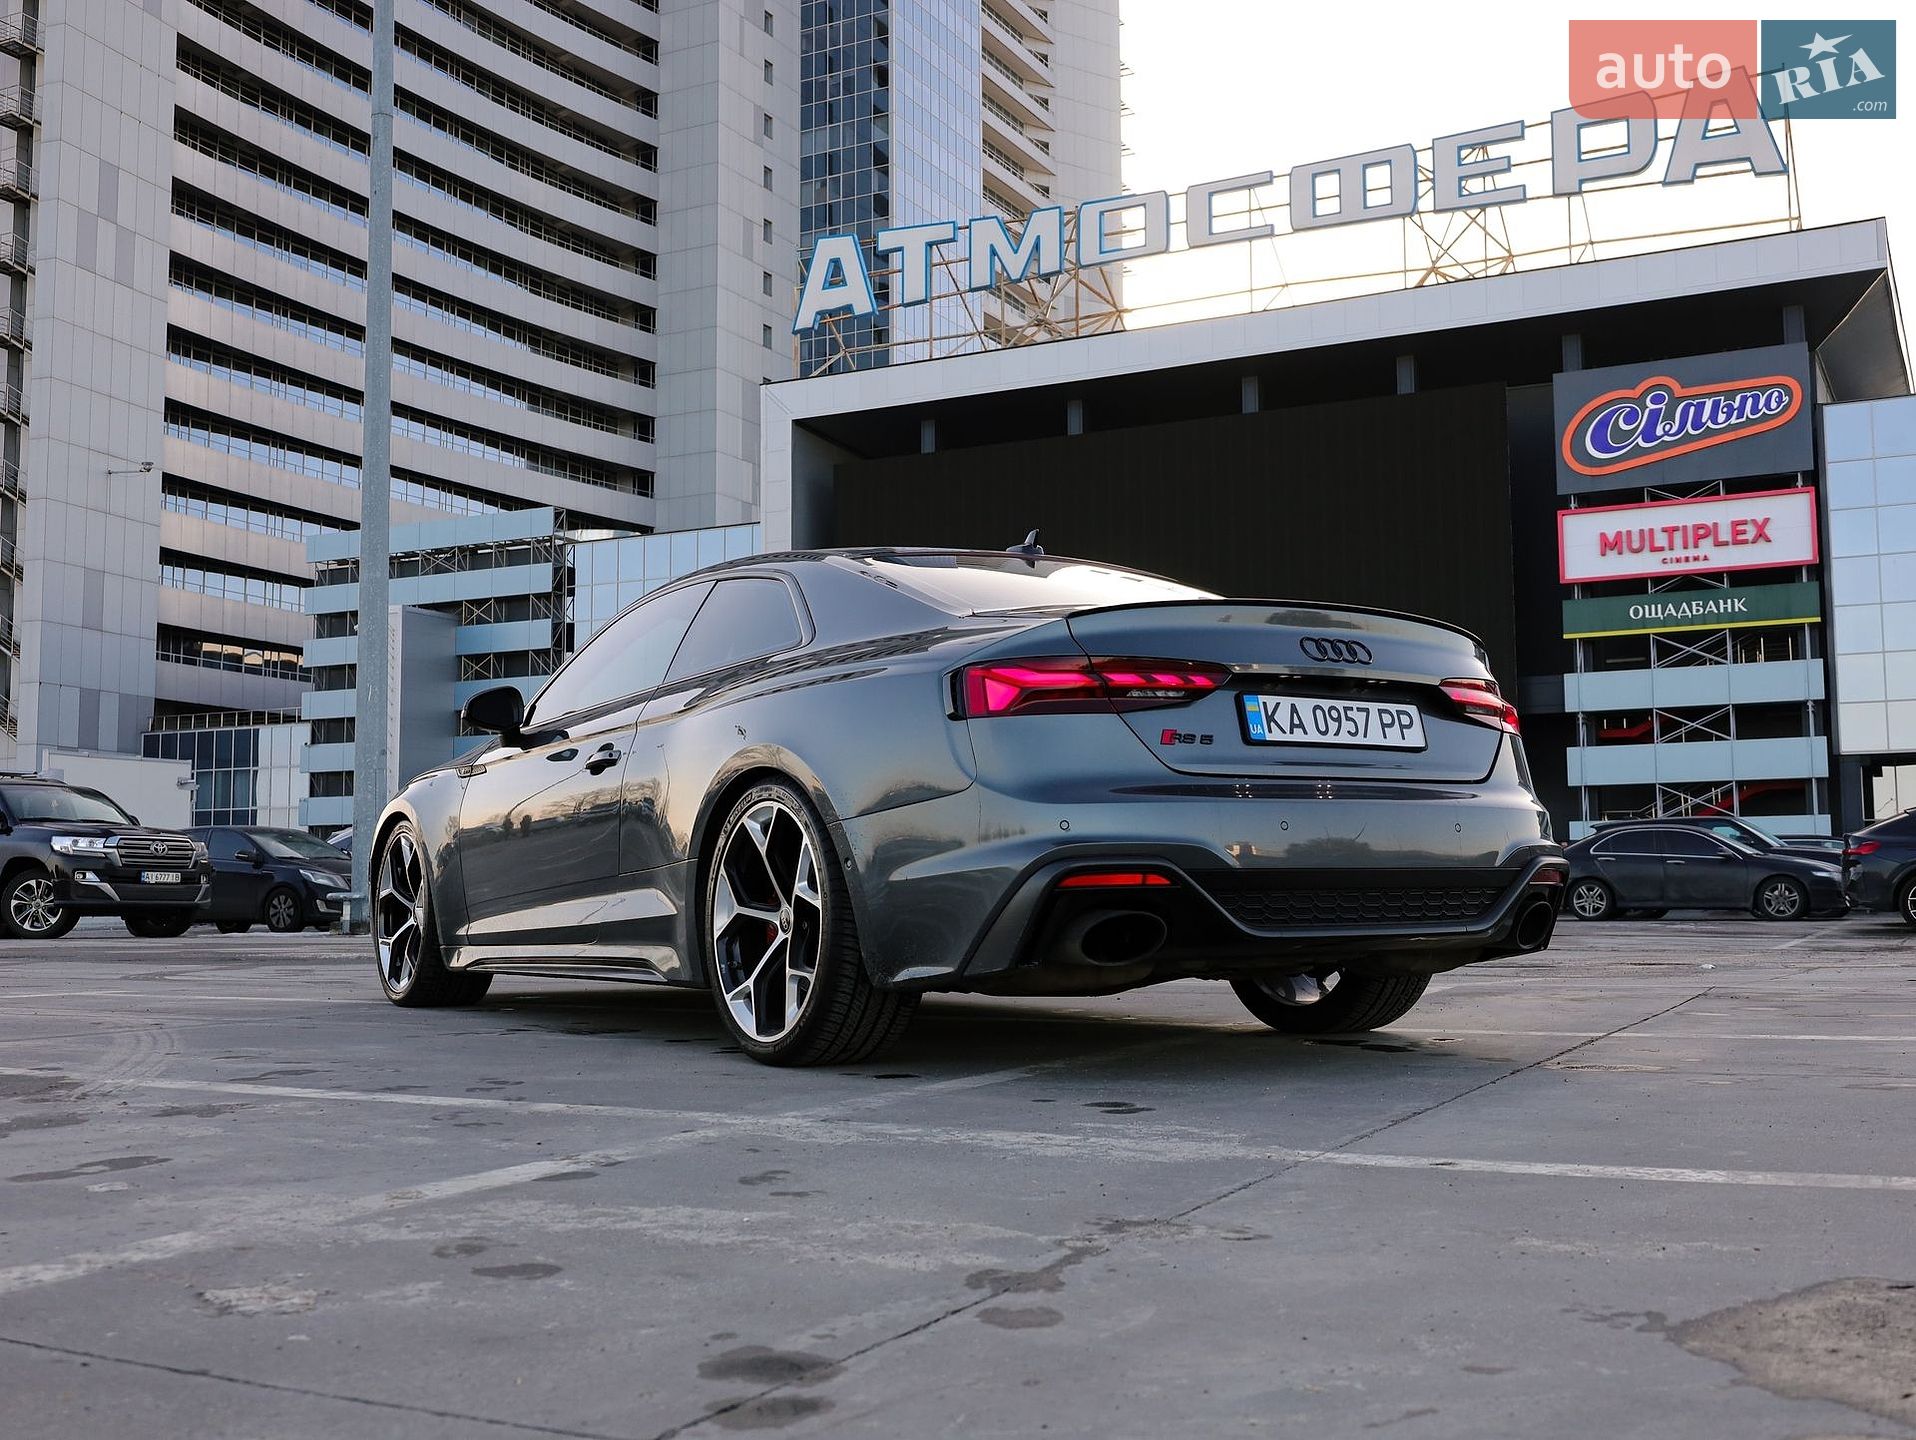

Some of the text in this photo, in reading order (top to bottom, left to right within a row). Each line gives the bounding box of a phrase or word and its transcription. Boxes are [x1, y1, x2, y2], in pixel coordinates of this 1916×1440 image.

[792, 64, 1789, 335] АТМОСФЕРА
[1585, 387, 1789, 459] Сільпо
[1599, 517, 1773, 556] MULTIPLEX
[1660, 554, 1711, 566] CINEMA
[1629, 597, 1748, 619] ОЩАДБАНК
[1250, 723, 1264, 735] UA
[1262, 701, 1414, 741] KA 0957 PP
